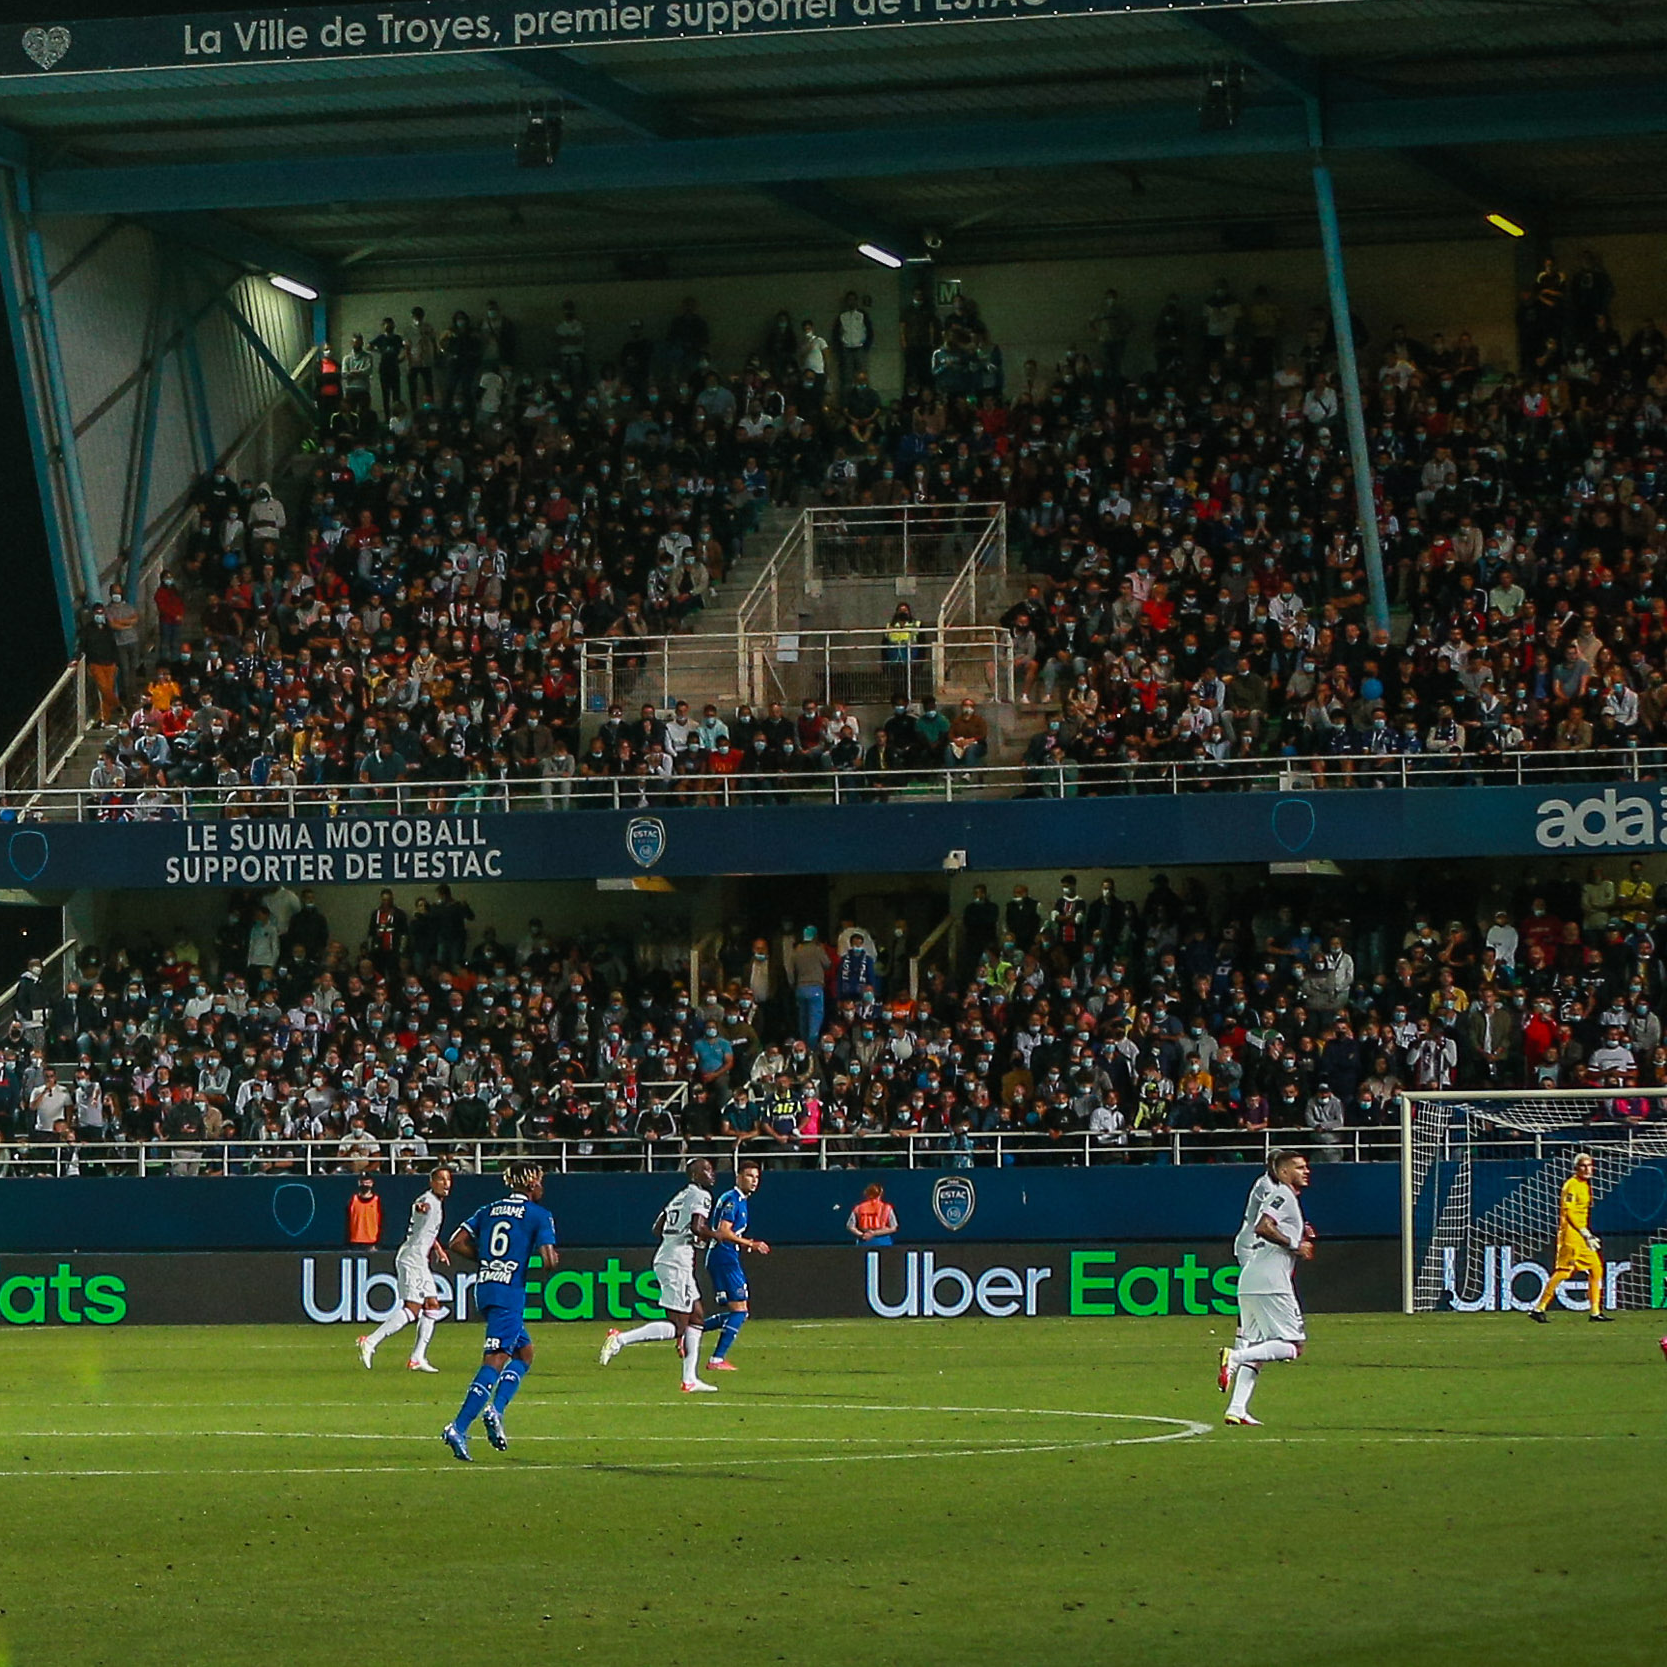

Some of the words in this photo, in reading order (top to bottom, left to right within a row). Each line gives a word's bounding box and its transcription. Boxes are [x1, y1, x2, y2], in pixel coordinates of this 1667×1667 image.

[184, 22, 222, 56] La
[233, 16, 307, 54] Ville
[320, 14, 366, 48] de
[377, 10, 500, 51] Troyes,
[513, 0, 655, 44] premier
[186, 825, 220, 852] LE
[230, 824, 315, 851] SUMA
[324, 819, 487, 850] MOTOBALL
[1536, 788, 1654, 847] ada
[166, 856, 335, 885] SUPPORTER
[345, 853, 383, 879] DE
[392, 849, 503, 877] L'ESTAC
[489, 1221, 512, 1257] 6
[867, 1250, 1052, 1318] Uber
[1071, 1250, 1242, 1316] Eats
[1443, 1245, 1631, 1311] Uber
